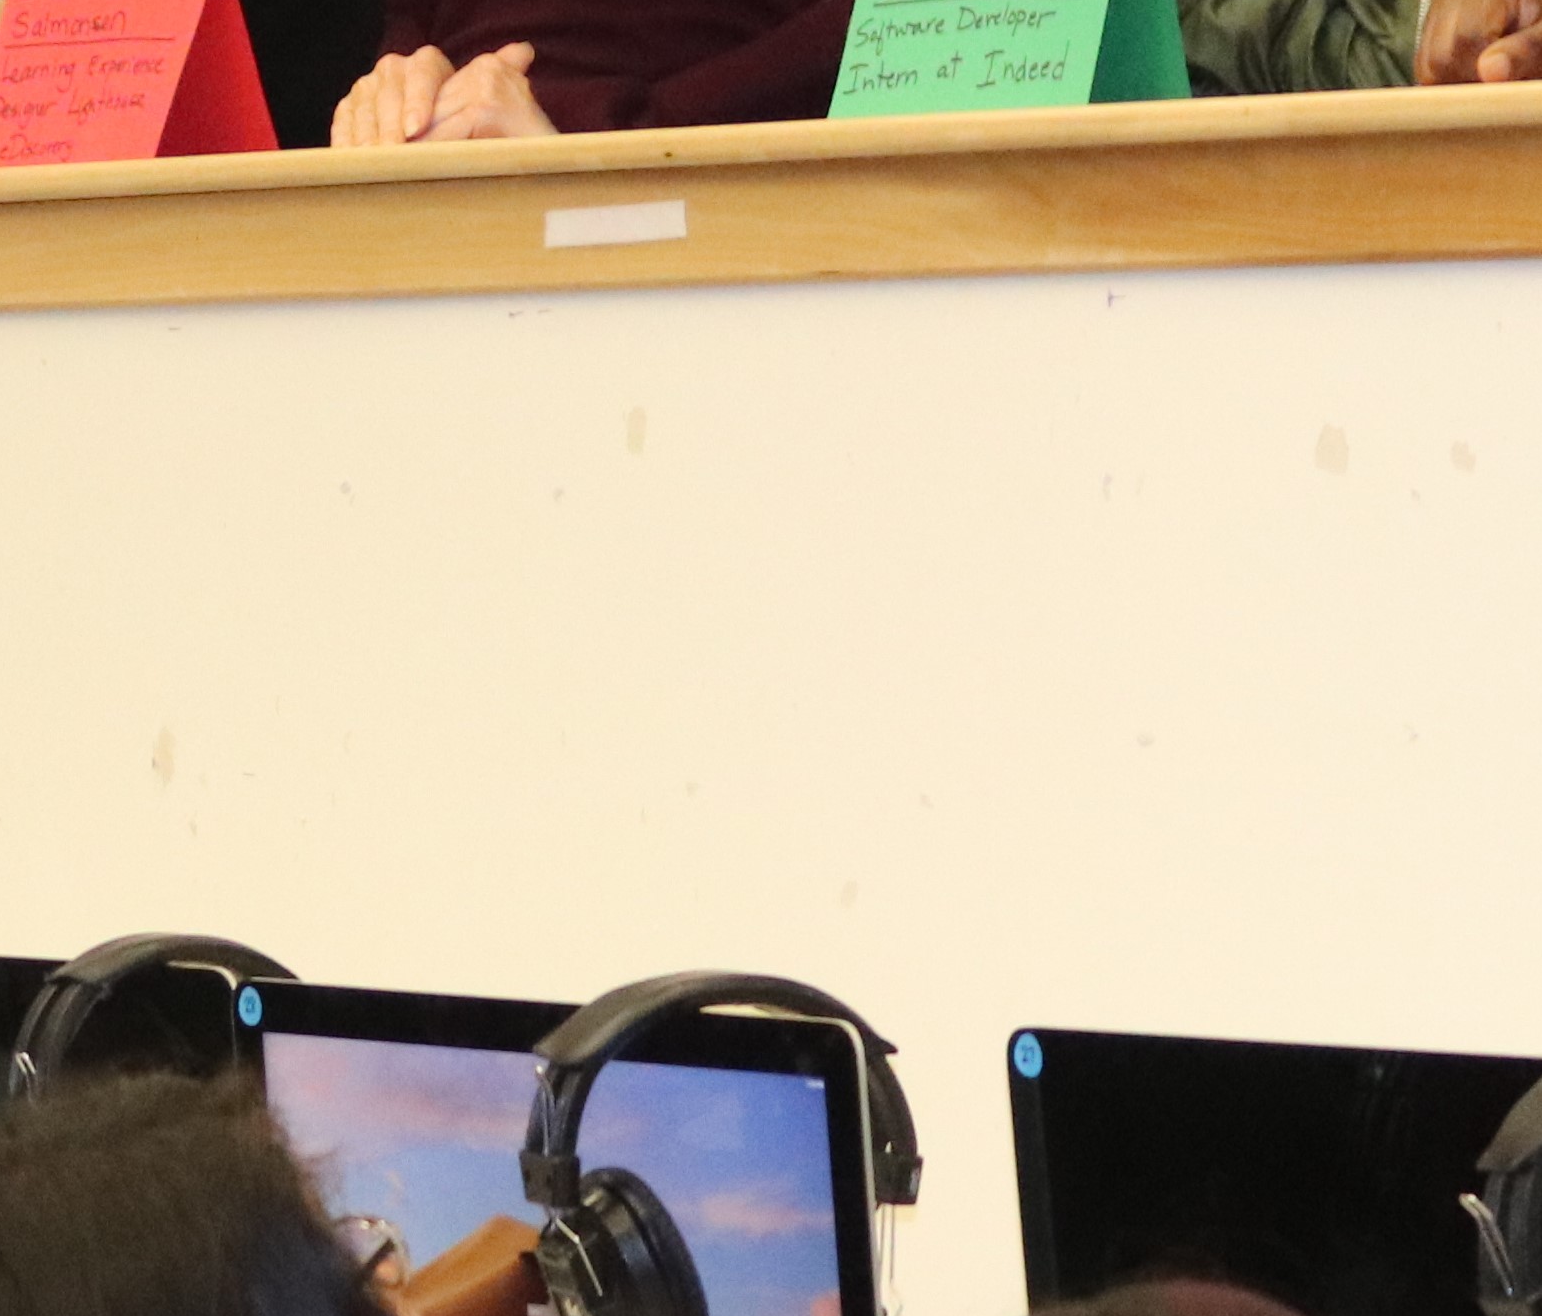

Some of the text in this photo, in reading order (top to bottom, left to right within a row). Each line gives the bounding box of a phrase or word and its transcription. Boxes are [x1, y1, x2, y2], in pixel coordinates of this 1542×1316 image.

[855, 5, 1056, 56] Software Developer
[2, 56, 76, 93] Learning
[842, 40, 1070, 95] Intern at Indeed
